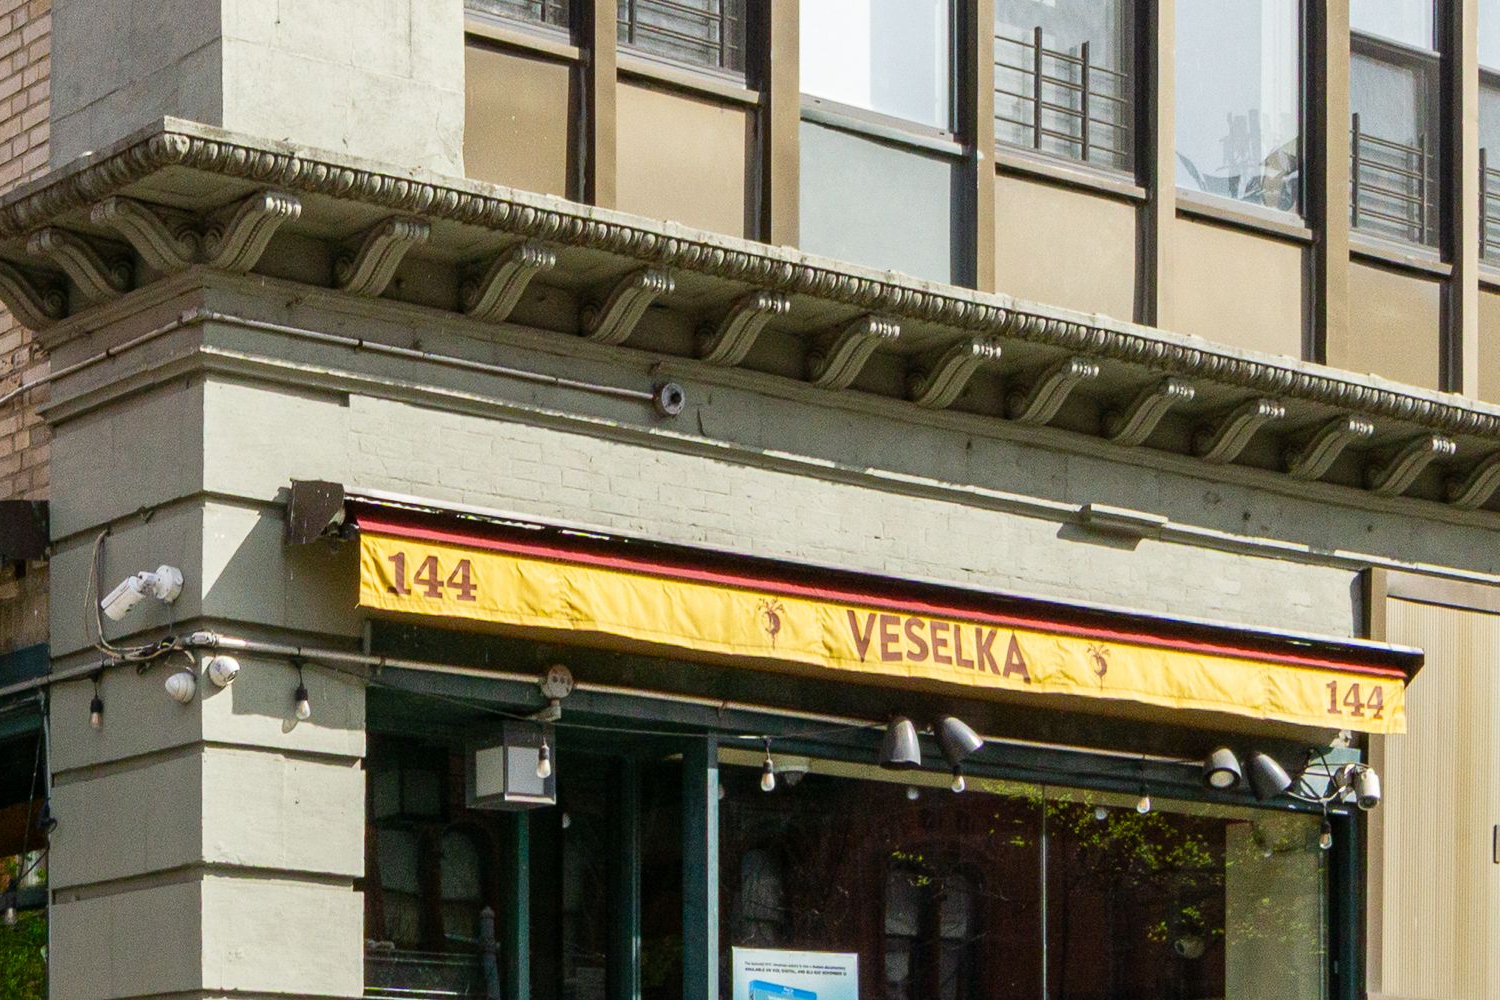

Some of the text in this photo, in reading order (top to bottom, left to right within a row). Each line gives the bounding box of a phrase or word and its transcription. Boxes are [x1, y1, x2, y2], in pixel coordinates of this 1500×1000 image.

[389, 551, 478, 603] 144
[847, 610, 1030, 683] VESELKA
[1326, 680, 1384, 720] 144
